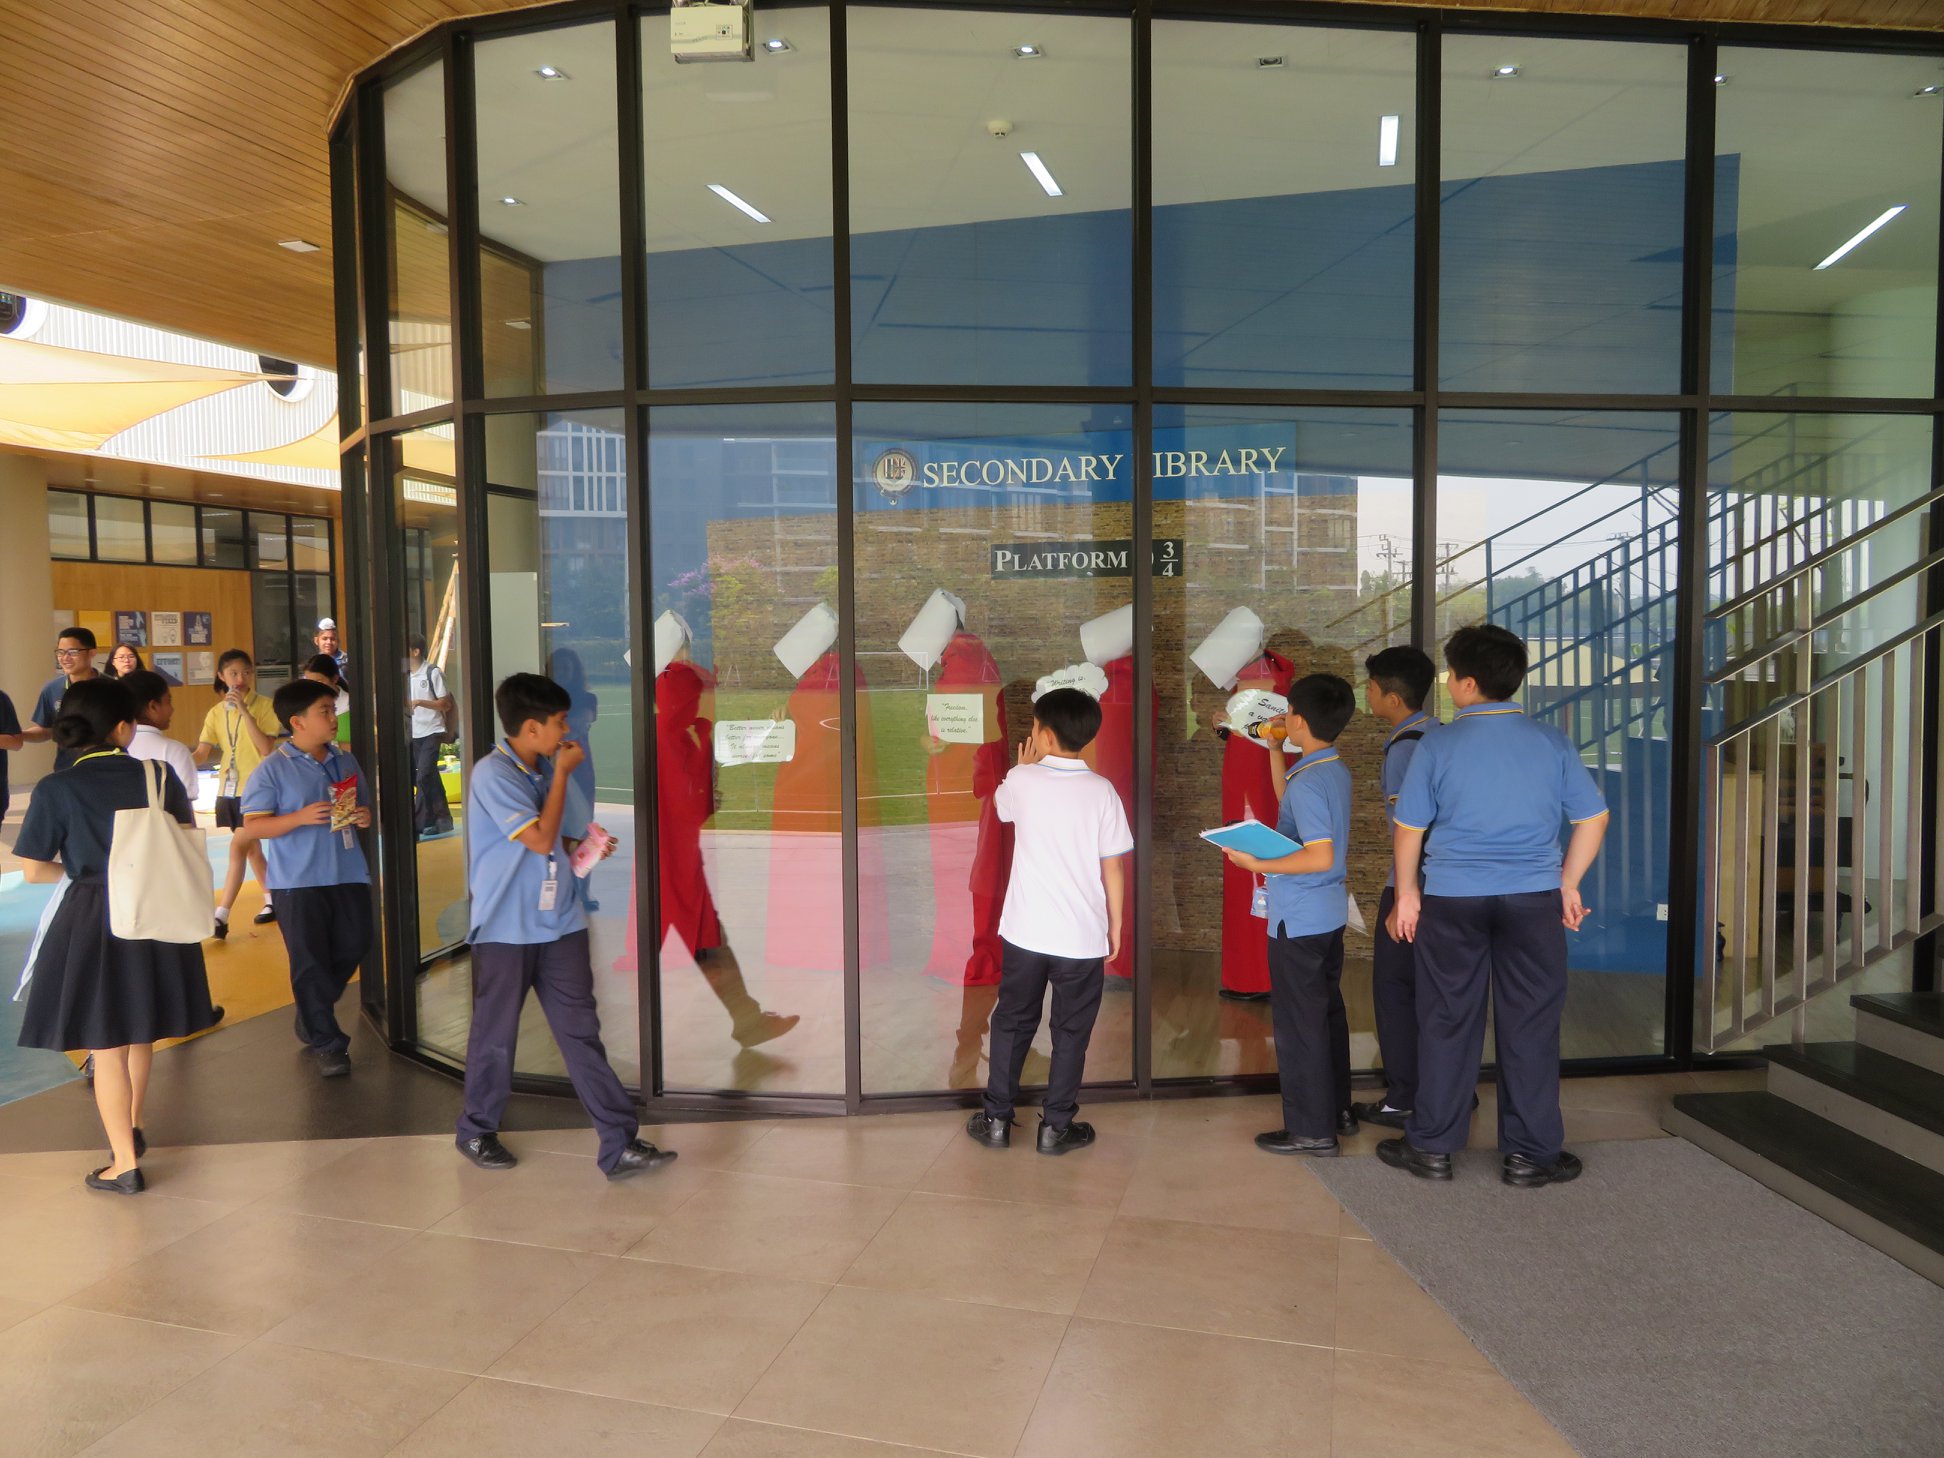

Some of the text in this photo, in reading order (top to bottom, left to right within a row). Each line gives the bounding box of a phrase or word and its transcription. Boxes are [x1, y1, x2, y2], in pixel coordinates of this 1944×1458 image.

[923, 454, 1124, 488] SECONDARY
[1152, 447, 1287, 478] IBRARY
[994, 550, 1129, 572] PLATFORM
[941, 715, 967, 724] everything
